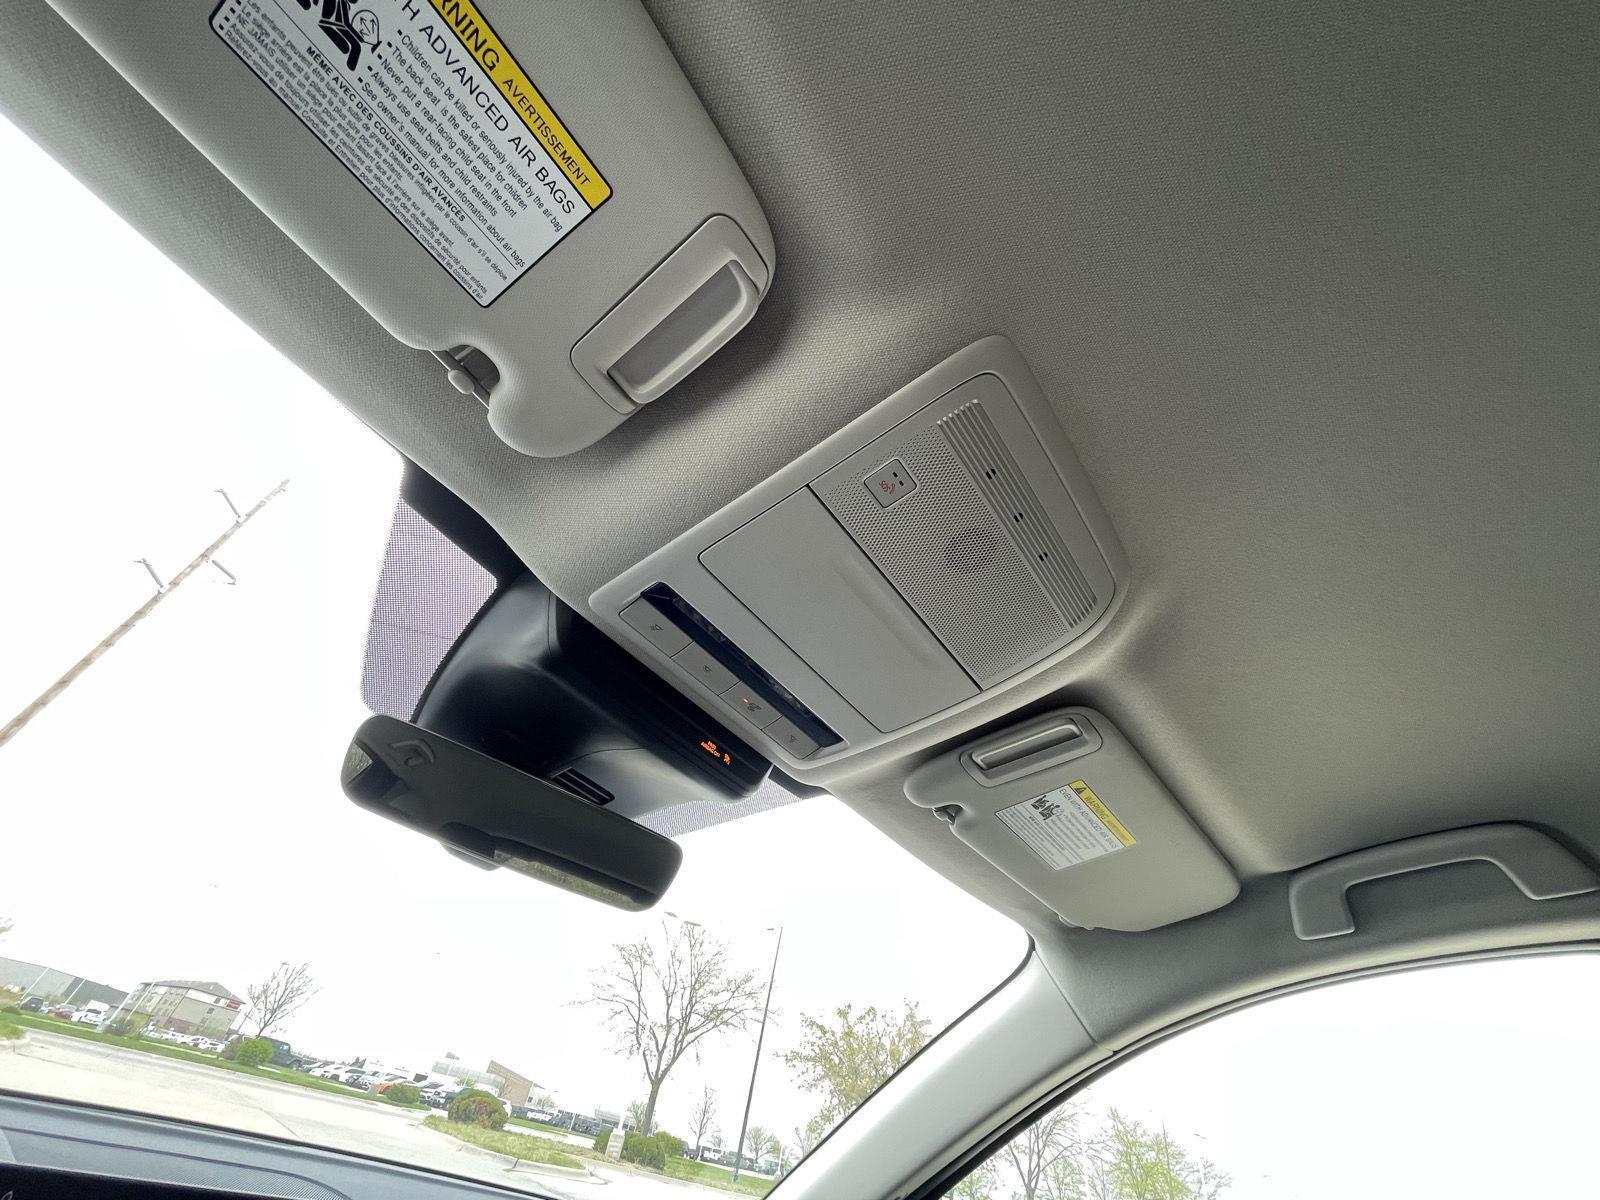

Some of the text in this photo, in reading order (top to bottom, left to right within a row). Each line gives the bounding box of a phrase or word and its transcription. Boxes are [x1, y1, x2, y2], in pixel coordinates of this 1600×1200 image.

[306, 45, 334, 77] MÊME
[331, 76, 357, 102] AVEC
[355, 100, 374, 121] DES
[373, 120, 413, 164] COUSSINS
[411, 162, 433, 187] D'AIR
[361, 81, 526, 268] See owner's manual for more information about air bags
[370, 71, 498, 217] Always use seat belts and child restraints
[380, 57, 518, 218] Never put a rear-facing child seat in the front
[391, 45, 528, 211] The back seat is the safest place for children
[401, 0, 575, 214] H ADVANCED AIR BAGS
[401, 34, 563, 233] Children can be killed or seriously injured by the air bag
[502, 78, 591, 186] AVERTISSEMENT
